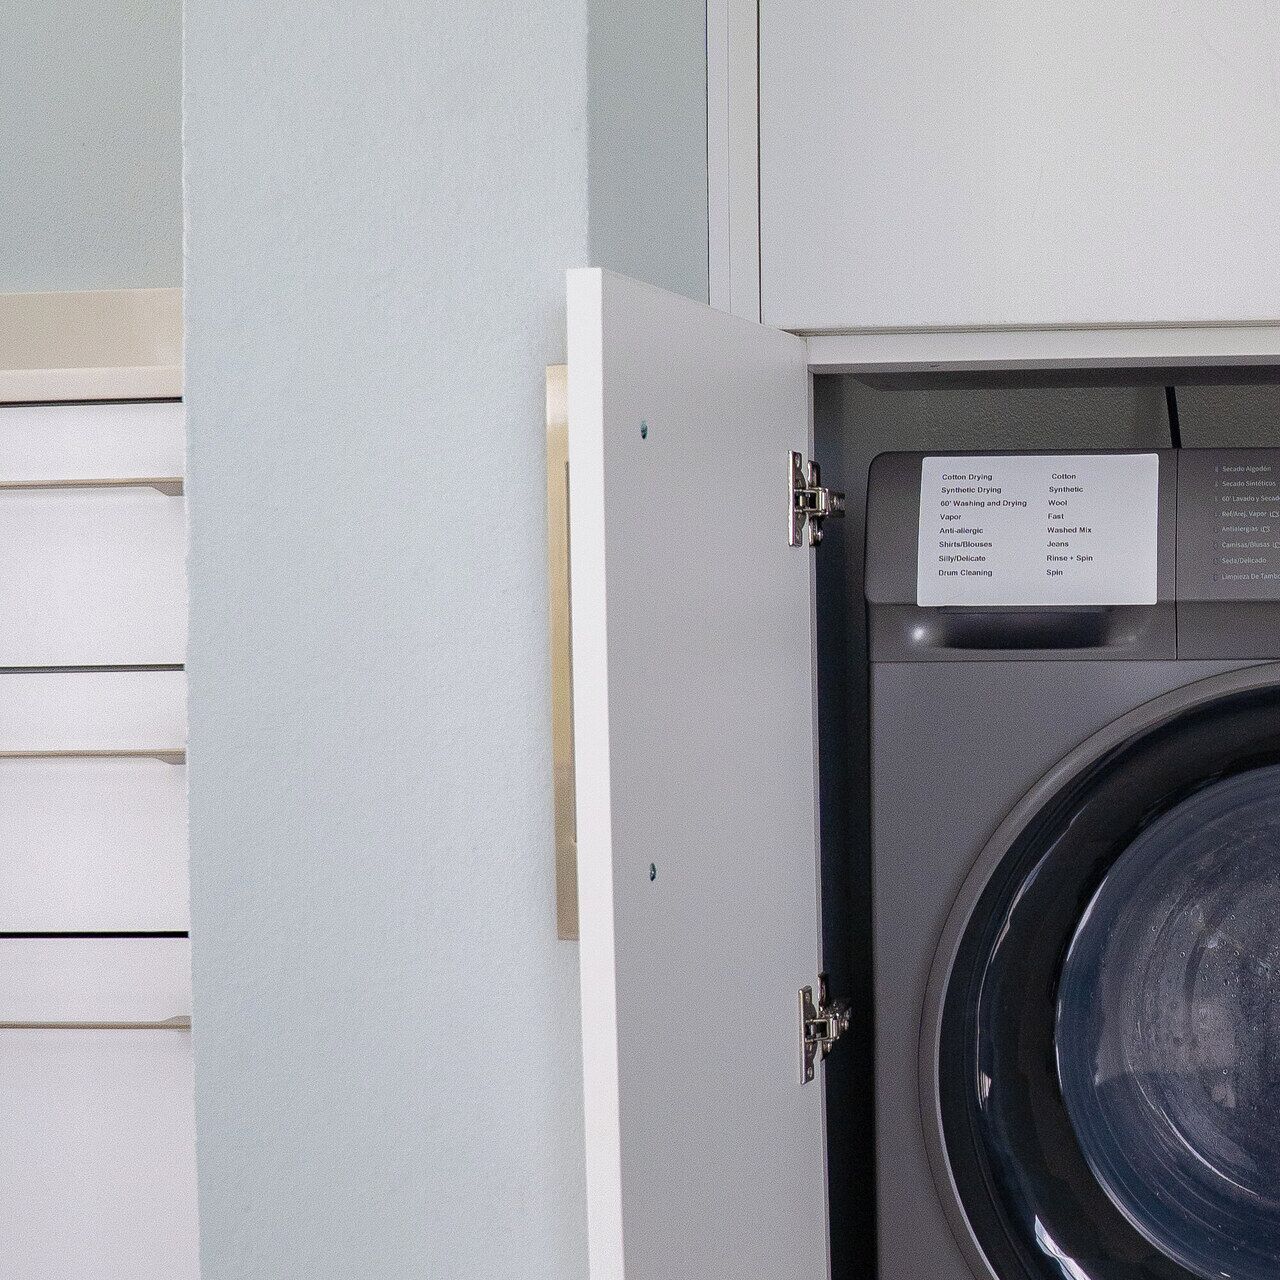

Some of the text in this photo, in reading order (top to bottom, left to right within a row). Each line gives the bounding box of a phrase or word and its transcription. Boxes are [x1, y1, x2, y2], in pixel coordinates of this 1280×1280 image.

[1246, 465, 1271, 473] Algodón
[953, 500, 985, 508] Washing
[1003, 500, 1027, 508] Drying
[940, 527, 983, 535] Anti-allergic
[938, 555, 986, 563] Silly/Delicate
[960, 569, 993, 577] Cleaning
[1046, 569, 1063, 577] Spin
